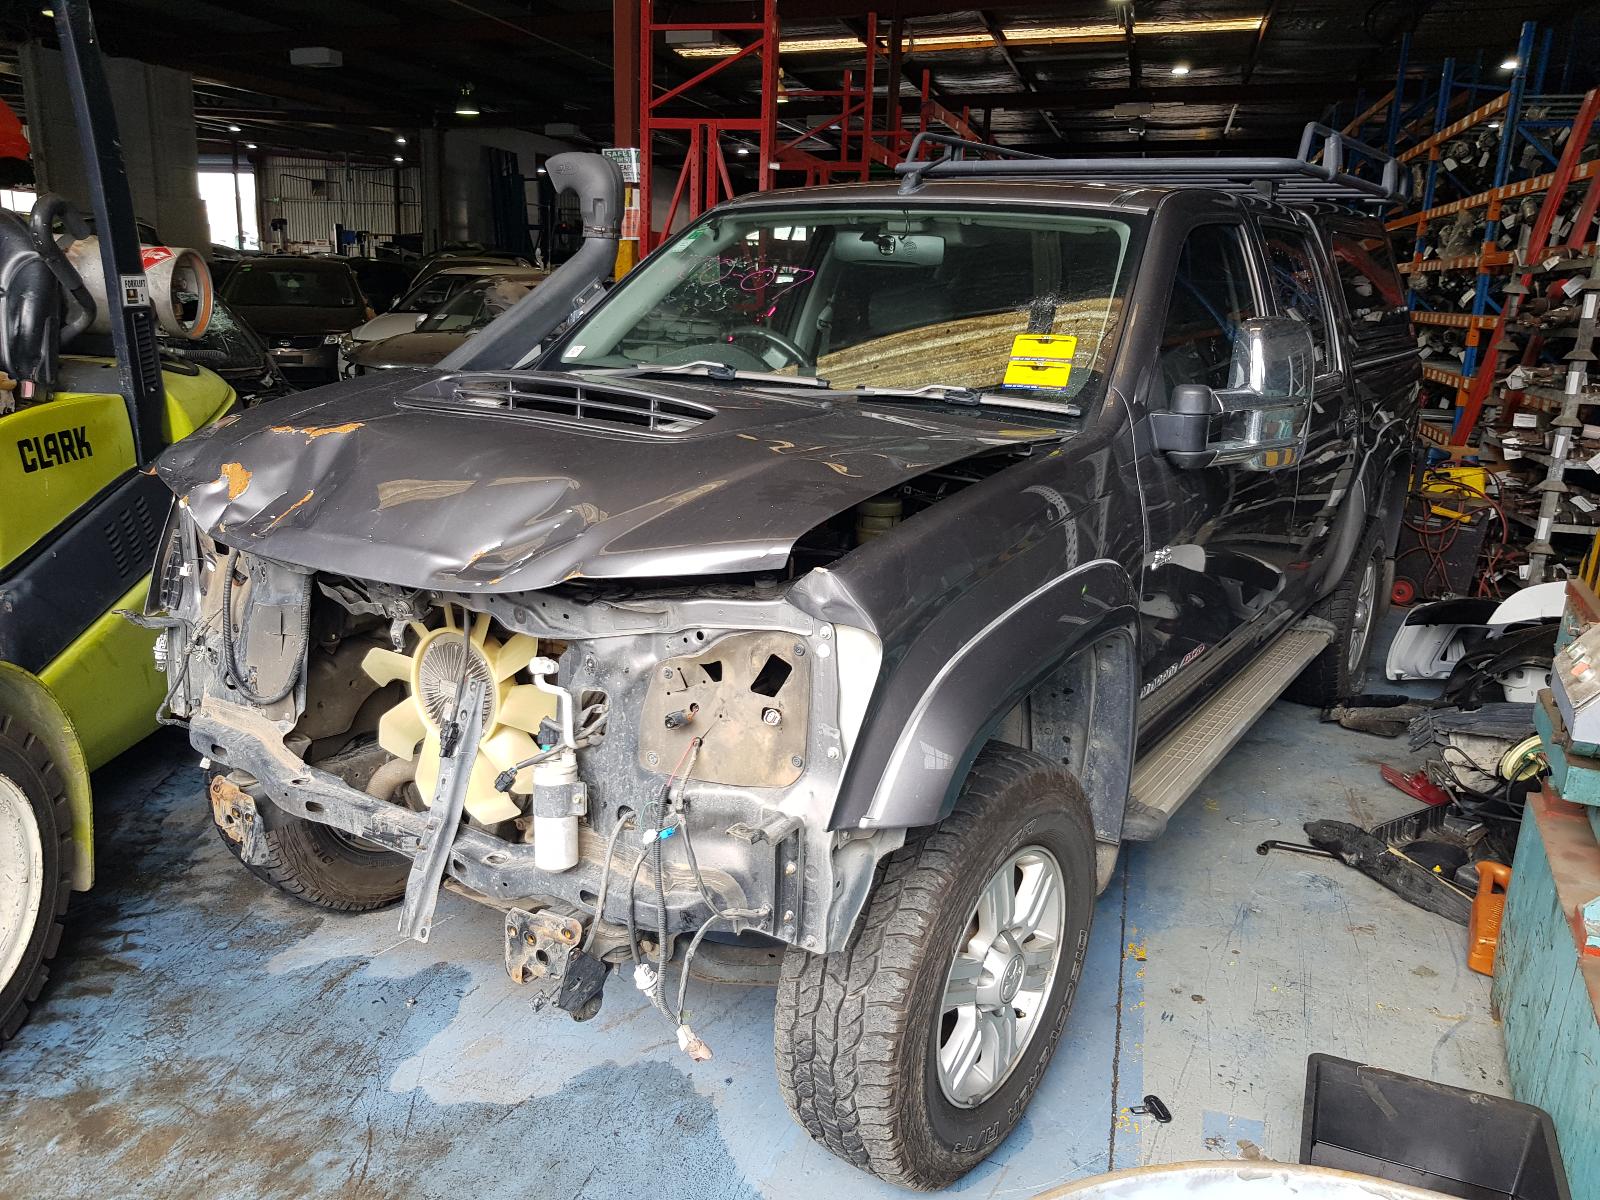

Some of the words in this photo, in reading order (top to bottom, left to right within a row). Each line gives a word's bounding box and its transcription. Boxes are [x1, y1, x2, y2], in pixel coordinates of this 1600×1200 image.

[124, 279, 146, 289] FORKLIFT
[17, 425, 93, 473] CLARK
[1006, 928, 1088, 1125] DISCOVERER
